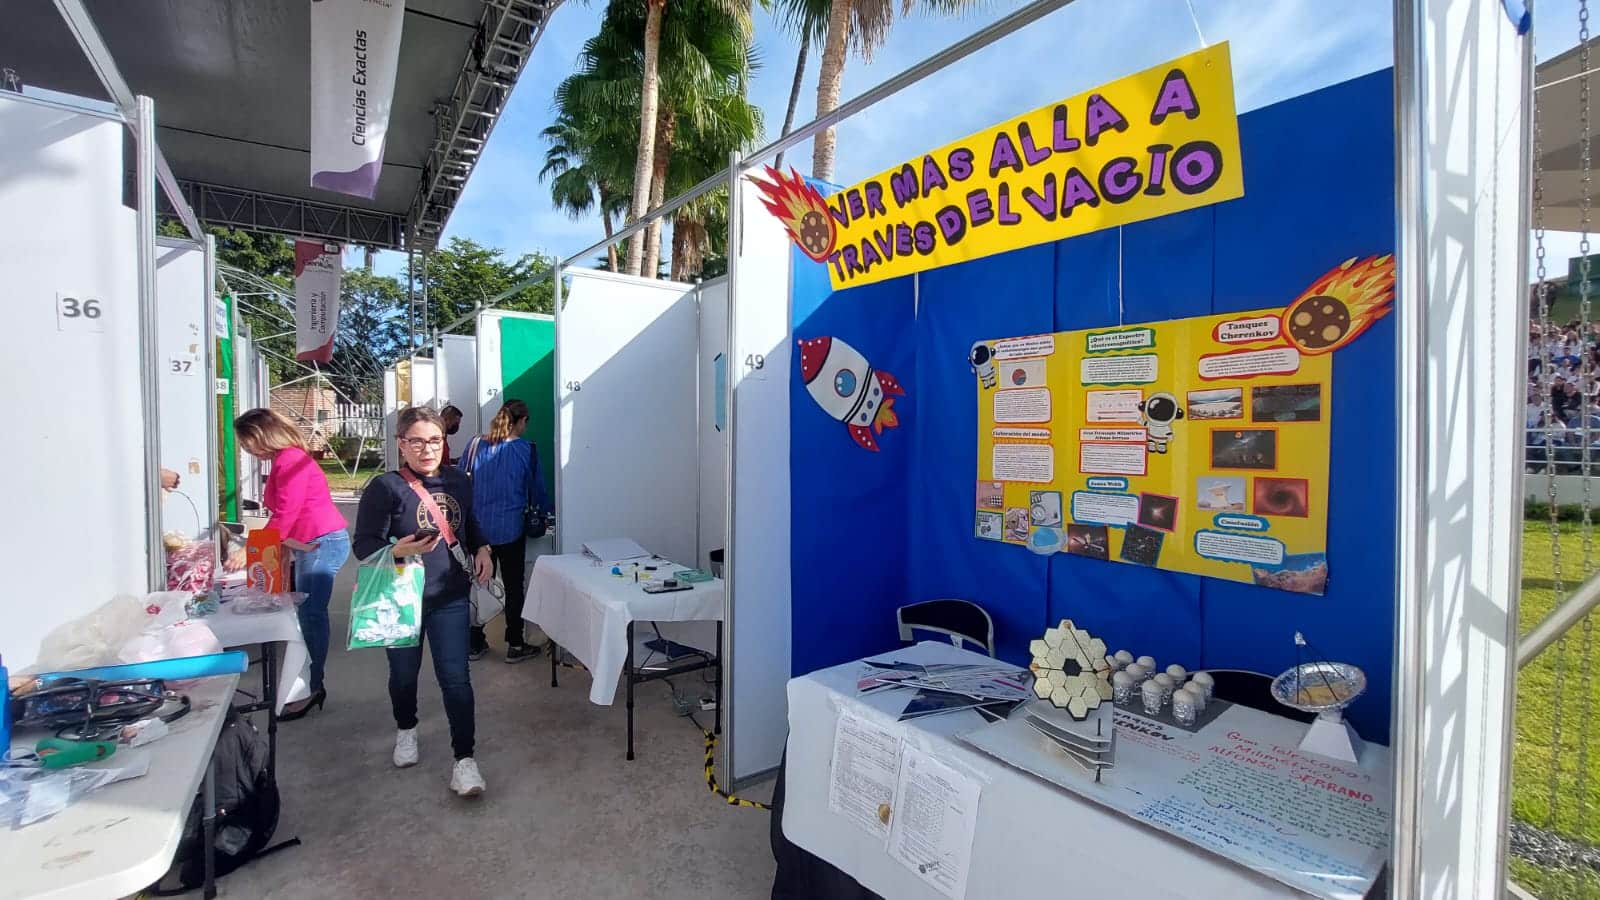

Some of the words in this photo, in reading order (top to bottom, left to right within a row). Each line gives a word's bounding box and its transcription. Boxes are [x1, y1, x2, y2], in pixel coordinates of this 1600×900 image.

[352, 29, 367, 86] Exactas
[352, 89, 367, 146] Ciencias
[829, 181, 887, 229] VER
[1150, 69, 1200, 125] A
[935, 182, 1021, 246] DEL
[1022, 141, 1223, 221] VACIO
[62, 298, 101, 319] 36
[1226, 321, 1269, 331] Tanques
[1220, 330, 1274, 340] Cherenkov
[171, 360, 192, 373] 37
[744, 353, 764, 370] 49
[486, 389, 499, 397] 47
[566, 380, 581, 392] 48
[1226, 730, 1259, 747] Gran
[1207, 745, 1277, 771] ALFONSO
[1288, 769, 1374, 802] SERRANO
